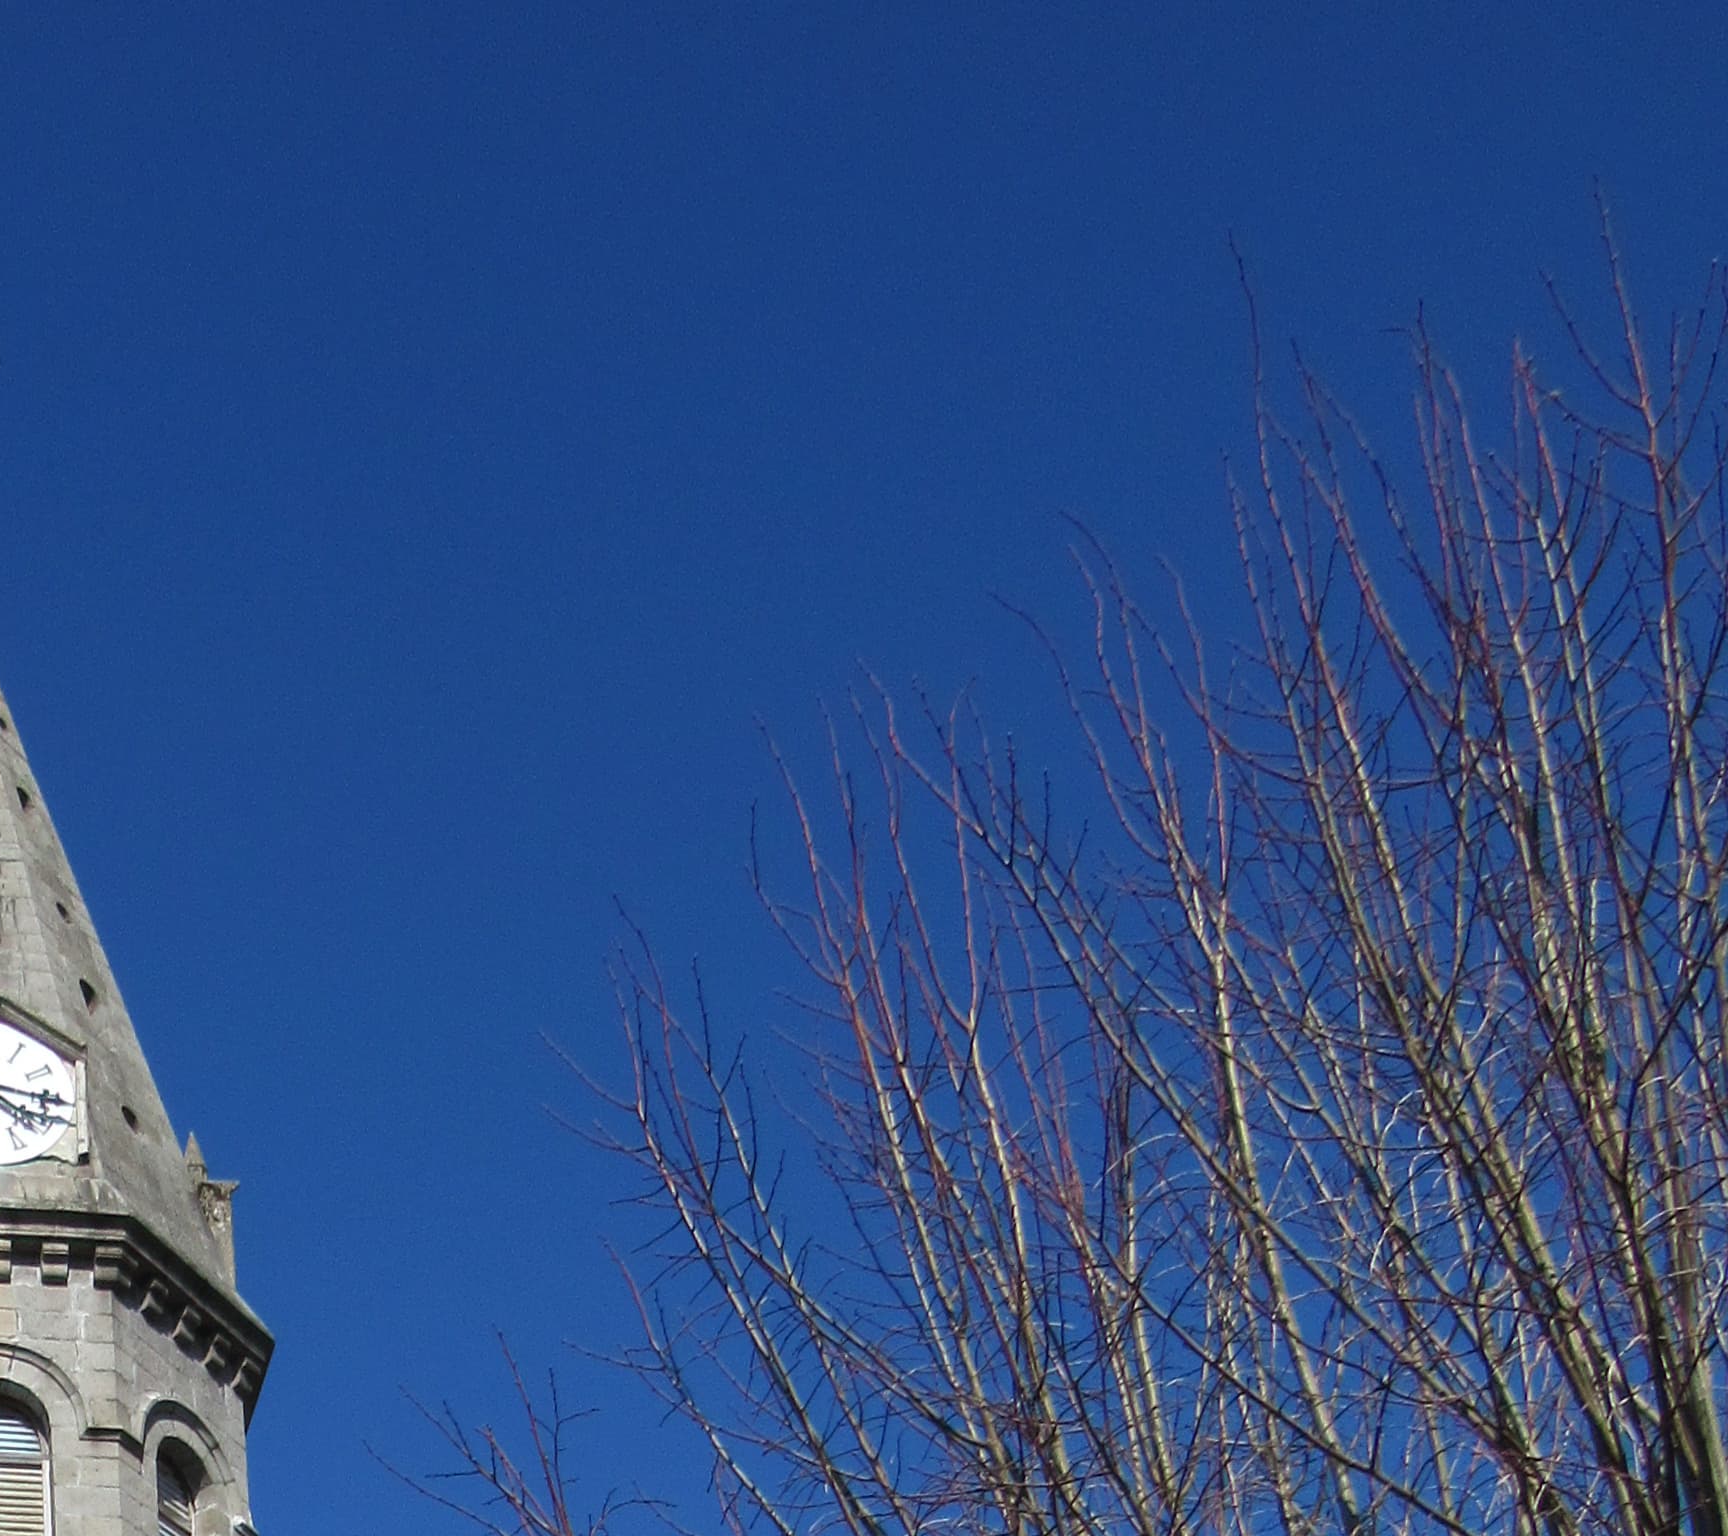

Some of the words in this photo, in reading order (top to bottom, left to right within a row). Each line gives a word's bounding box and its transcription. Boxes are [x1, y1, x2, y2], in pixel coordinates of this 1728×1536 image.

[7, 1042, 27, 1064] I
[24, 1064, 53, 1082] II
[5, 1126, 29, 1151] V
